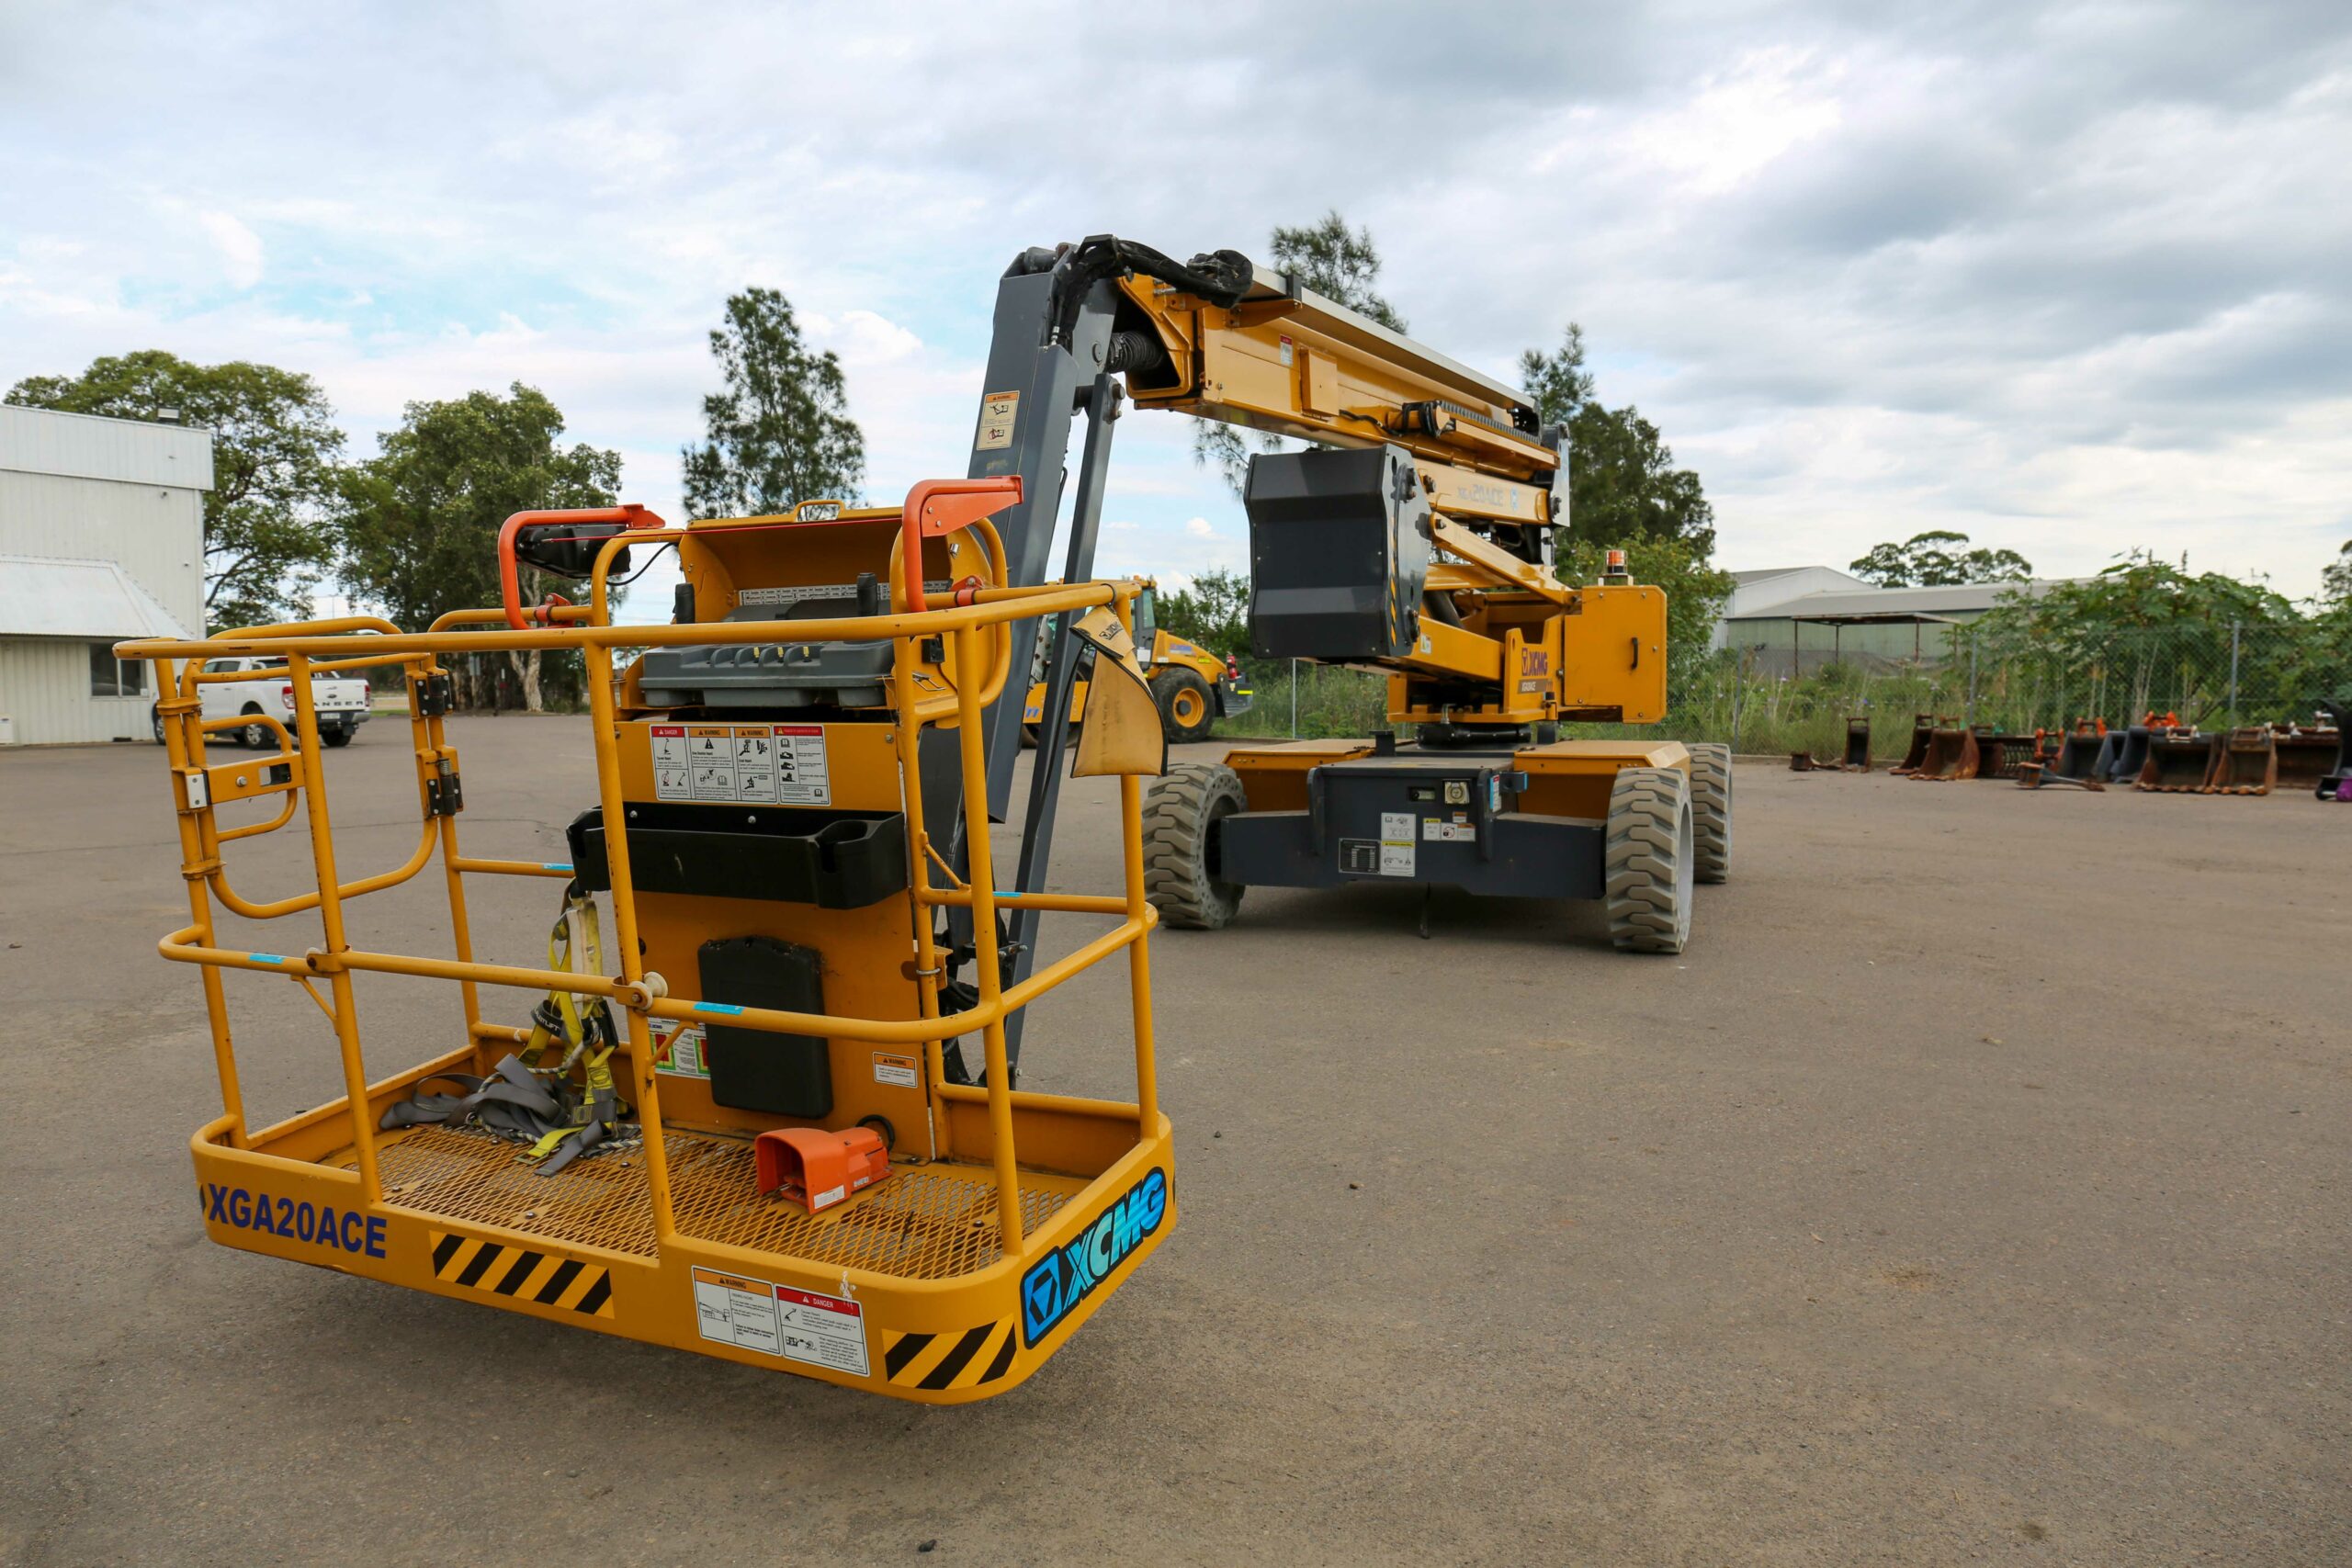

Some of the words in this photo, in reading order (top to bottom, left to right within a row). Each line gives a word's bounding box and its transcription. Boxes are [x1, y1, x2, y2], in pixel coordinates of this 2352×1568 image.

[1529, 651, 1548, 676] XCMG
[208, 1182, 387, 1259] XGA20ACE
[1062, 1171, 1166, 1312] XCMG
[725, 1278, 747, 1290] WARNING
[813, 1297, 834, 1309] DANGER
